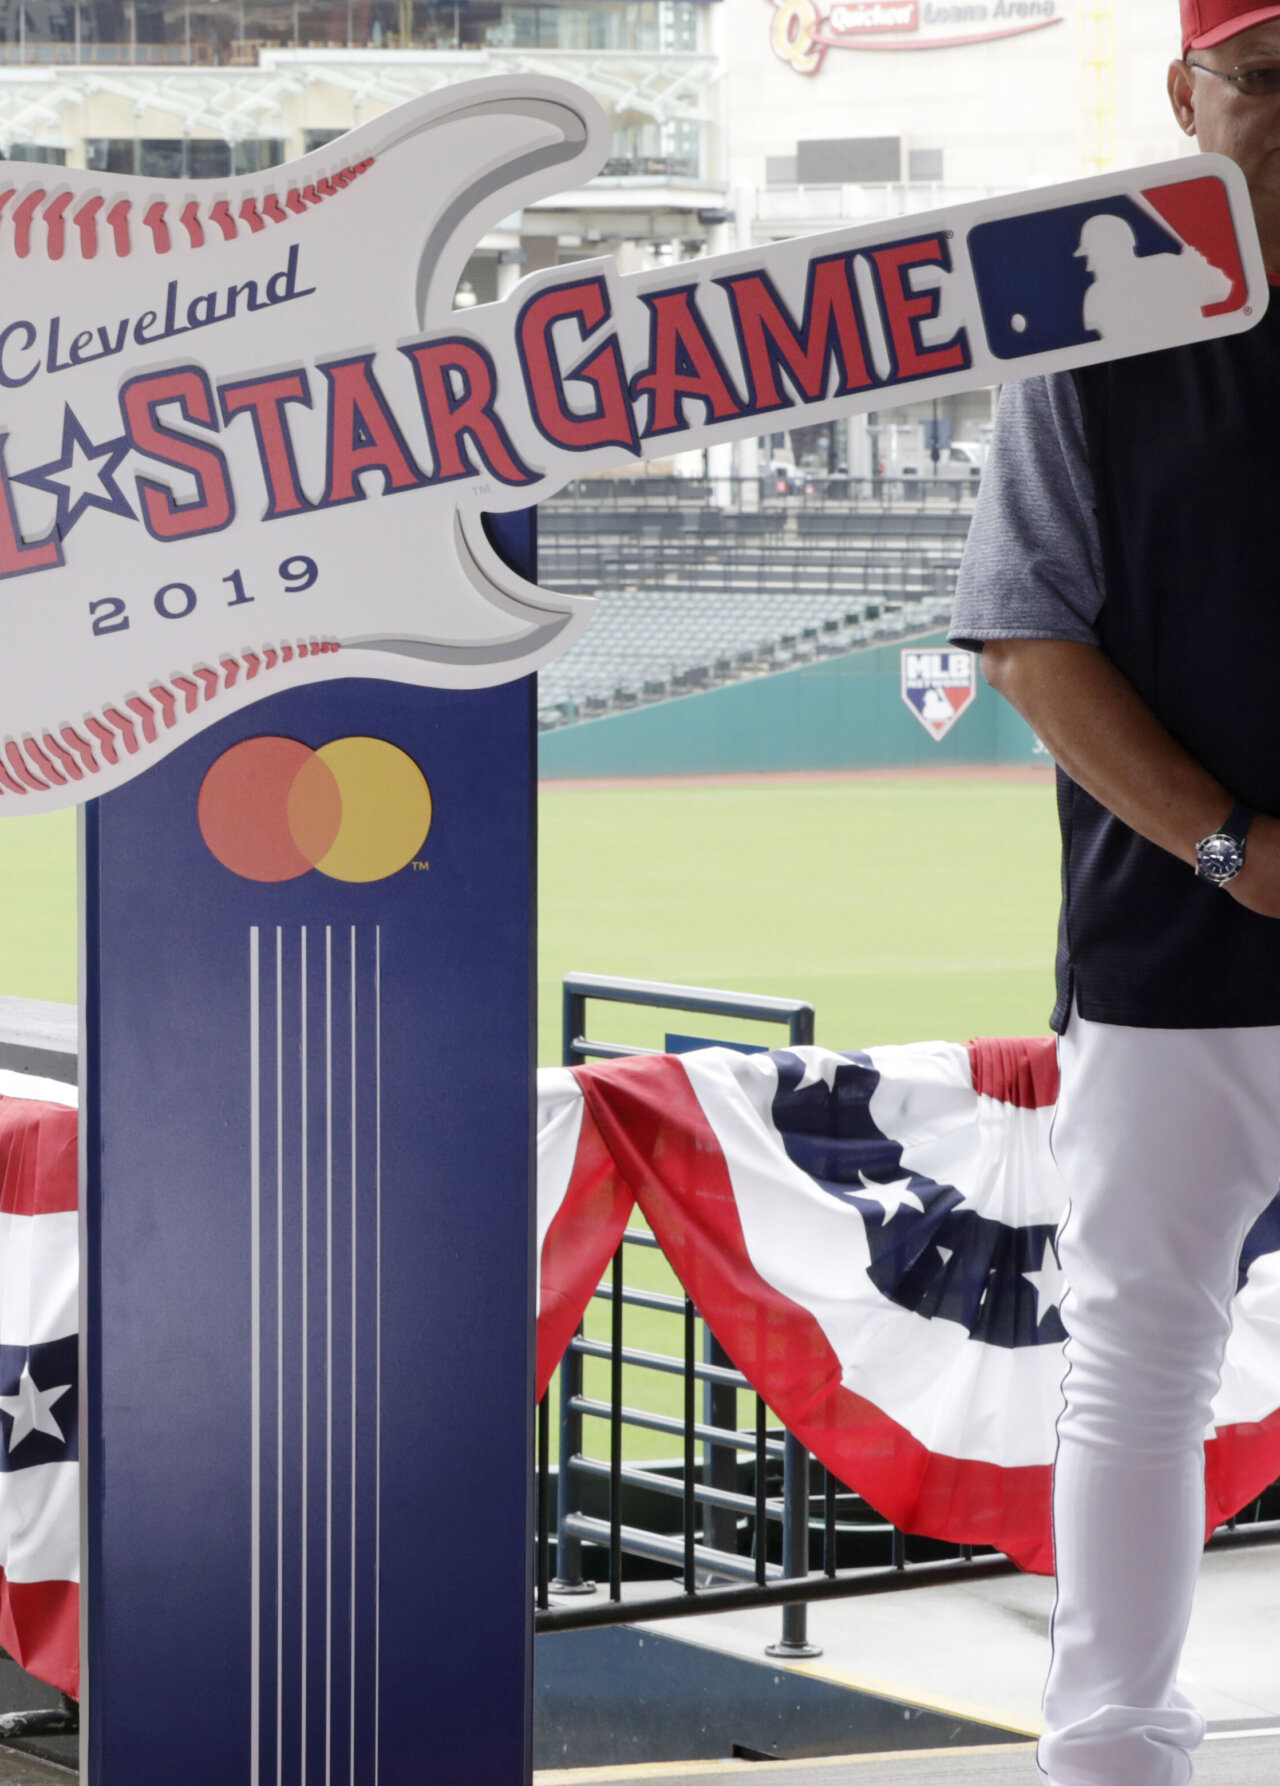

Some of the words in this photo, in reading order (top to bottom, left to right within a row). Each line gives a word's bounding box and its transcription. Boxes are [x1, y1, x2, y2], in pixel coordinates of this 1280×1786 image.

[118, 333, 545, 543] STAR
[515, 230, 972, 458] GAME
[89, 555, 320, 637] 2019
[906, 653, 971, 679] MLB
